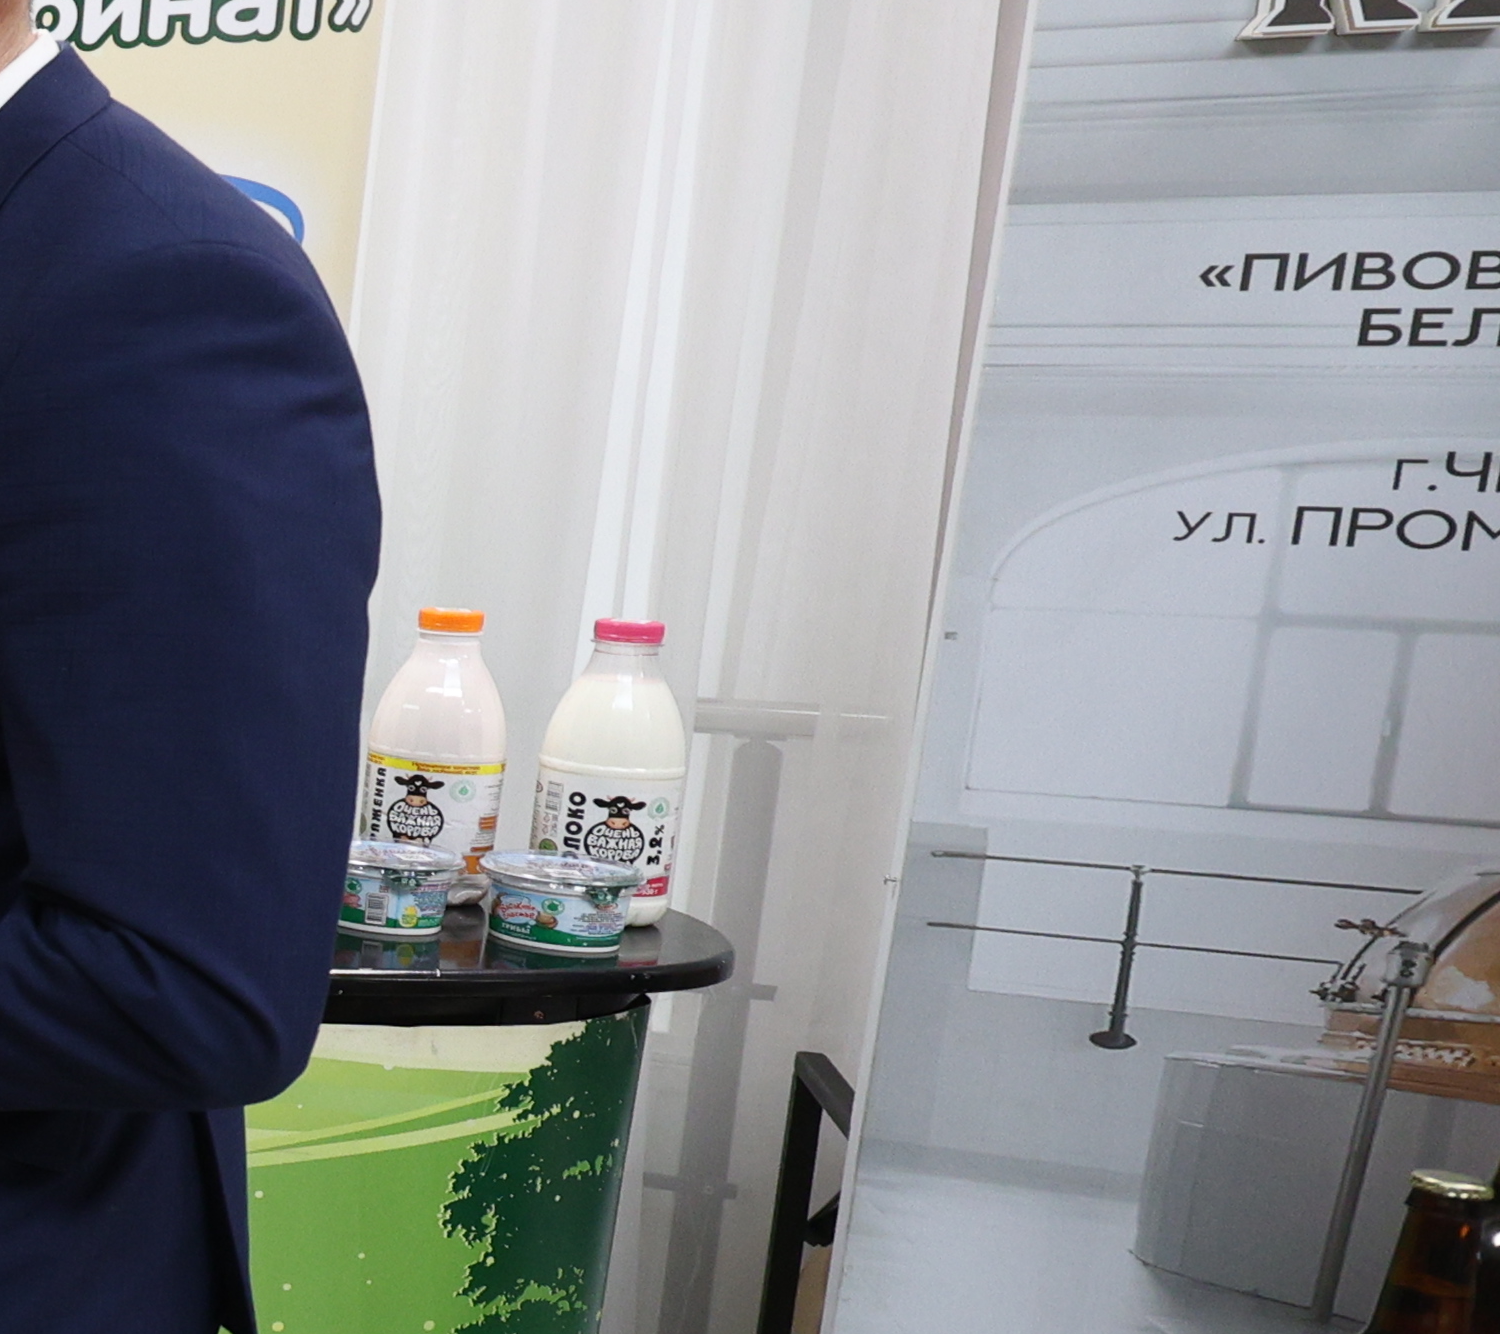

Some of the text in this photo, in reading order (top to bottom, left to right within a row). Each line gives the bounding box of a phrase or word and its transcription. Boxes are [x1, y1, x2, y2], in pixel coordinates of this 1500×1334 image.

[394, 802, 438, 816] ОЧЕНЬ
[389, 812, 442, 827] ВАЖНАЯ
[391, 822, 439, 836] КОРОВА
[592, 826, 640, 838] ОЧЕНЬ
[587, 835, 642, 850] ВАЖНАЯ
[646, 824, 666, 866] 3,2%
[589, 846, 639, 861] КОРОВА
